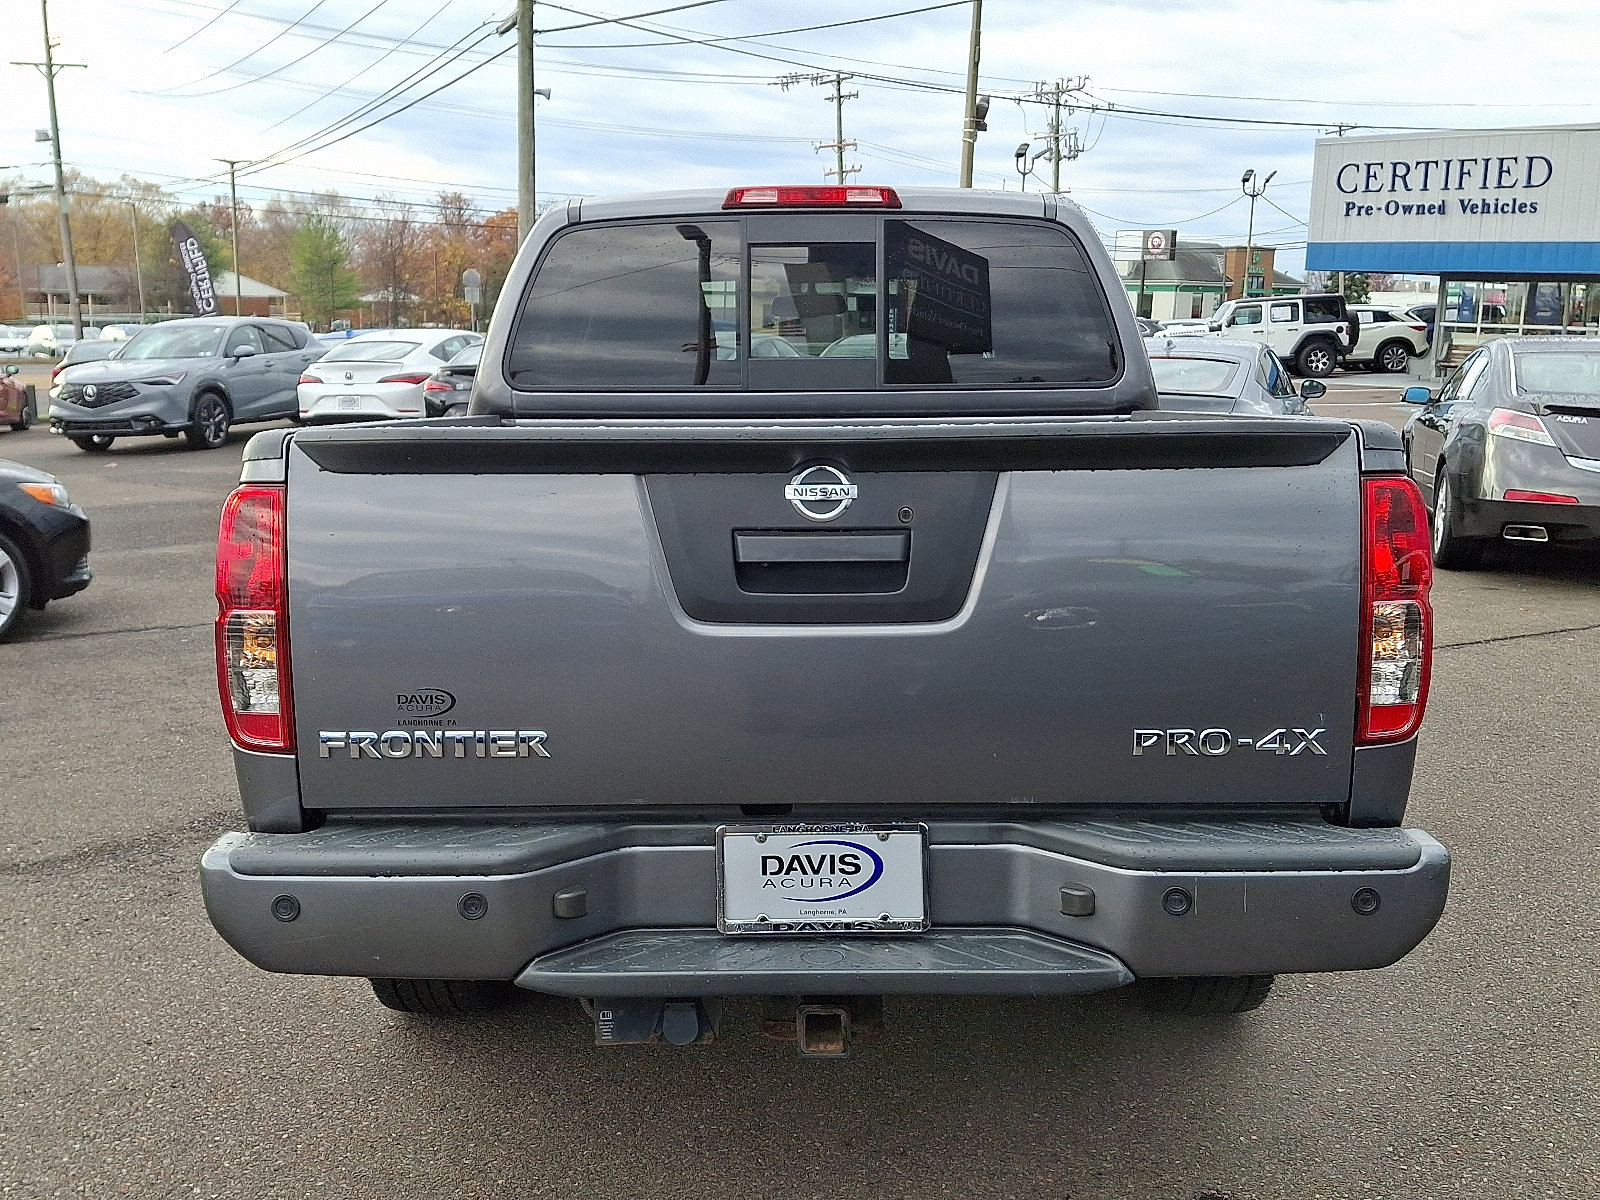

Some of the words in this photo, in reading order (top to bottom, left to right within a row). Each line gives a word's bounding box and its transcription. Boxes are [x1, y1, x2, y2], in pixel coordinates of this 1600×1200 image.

[1336, 155, 1553, 194] CERTIFIED
[1343, 199, 1446, 217] Pre-Owned
[1458, 197, 1538, 216] Vehicles
[1555, 415, 1589, 425] ACURA
[793, 487, 850, 498] NISSAN
[397, 694, 446, 705] DAVIS
[396, 704, 442, 712] ACURA
[318, 730, 551, 759] FRONTIER
[1132, 728, 1328, 756] PRO-4X
[760, 853, 862, 876] DAVIS
[762, 878, 852, 889] ACURA
[799, 909, 837, 917] Langhorne,
[772, 921, 876, 932] DAVIS
